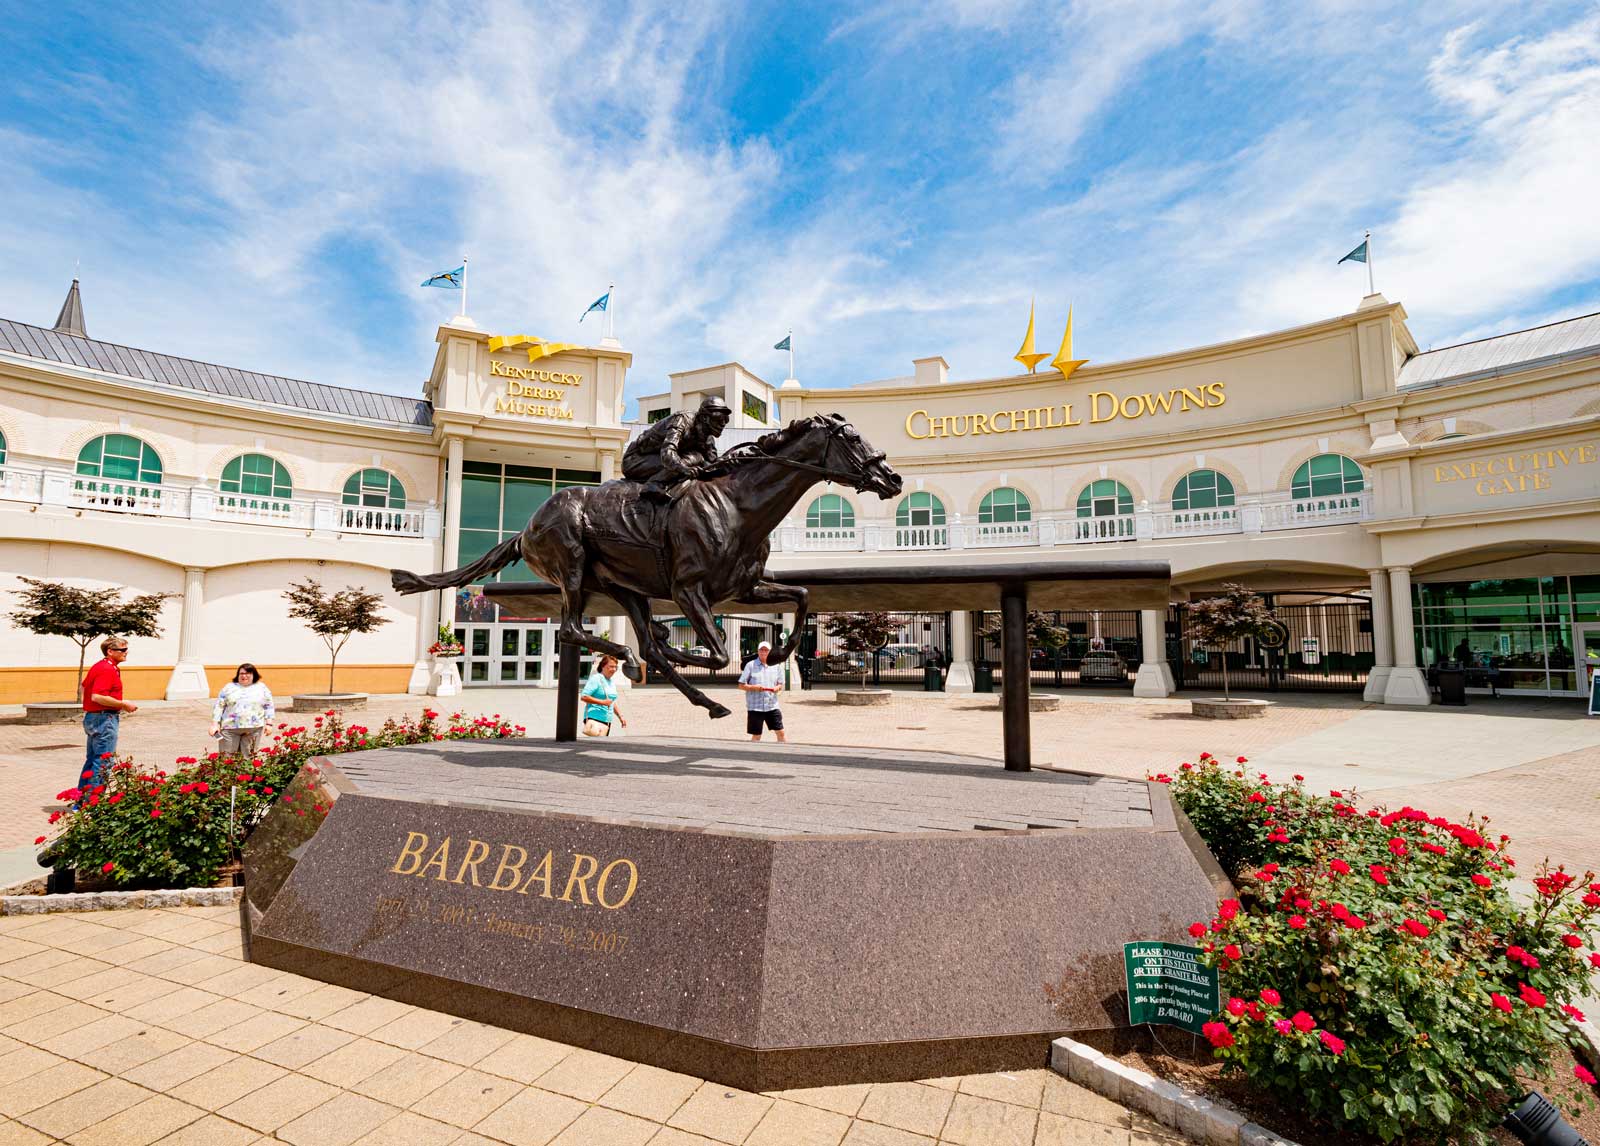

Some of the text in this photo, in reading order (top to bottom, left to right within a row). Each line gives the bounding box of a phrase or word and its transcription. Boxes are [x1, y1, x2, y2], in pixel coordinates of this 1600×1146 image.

[490, 360, 583, 385] KENTUCKY
[507, 381, 564, 401] DERBY
[495, 397, 574, 419] MUSEUM
[904, 382, 1226, 440] CHURCHILL DOWNS
[1433, 445, 1598, 483] EXECUTIVE
[1475, 472, 1551, 497] GATE
[389, 831, 638, 909] BARBARO
[581, 928, 630, 954] 2007
[1132, 948, 1163, 957] PLEASE
[1171, 950, 1186, 960] NOT
[1144, 957, 1157, 965] ON
[1173, 960, 1198, 972] STATUE
[1134, 967, 1144, 976] OR
[1145, 967, 1163, 976] THE
[1164, 968, 1191, 980] GRANITE
[1135, 982, 1147, 990] This
[1154, 982, 1164, 990] the
[1190, 988, 1203, 998] Place
[1203, 992, 1210, 1000] of
[1176, 999, 1191, 1011] Derby
[1191, 1003, 1213, 1015] Winner
